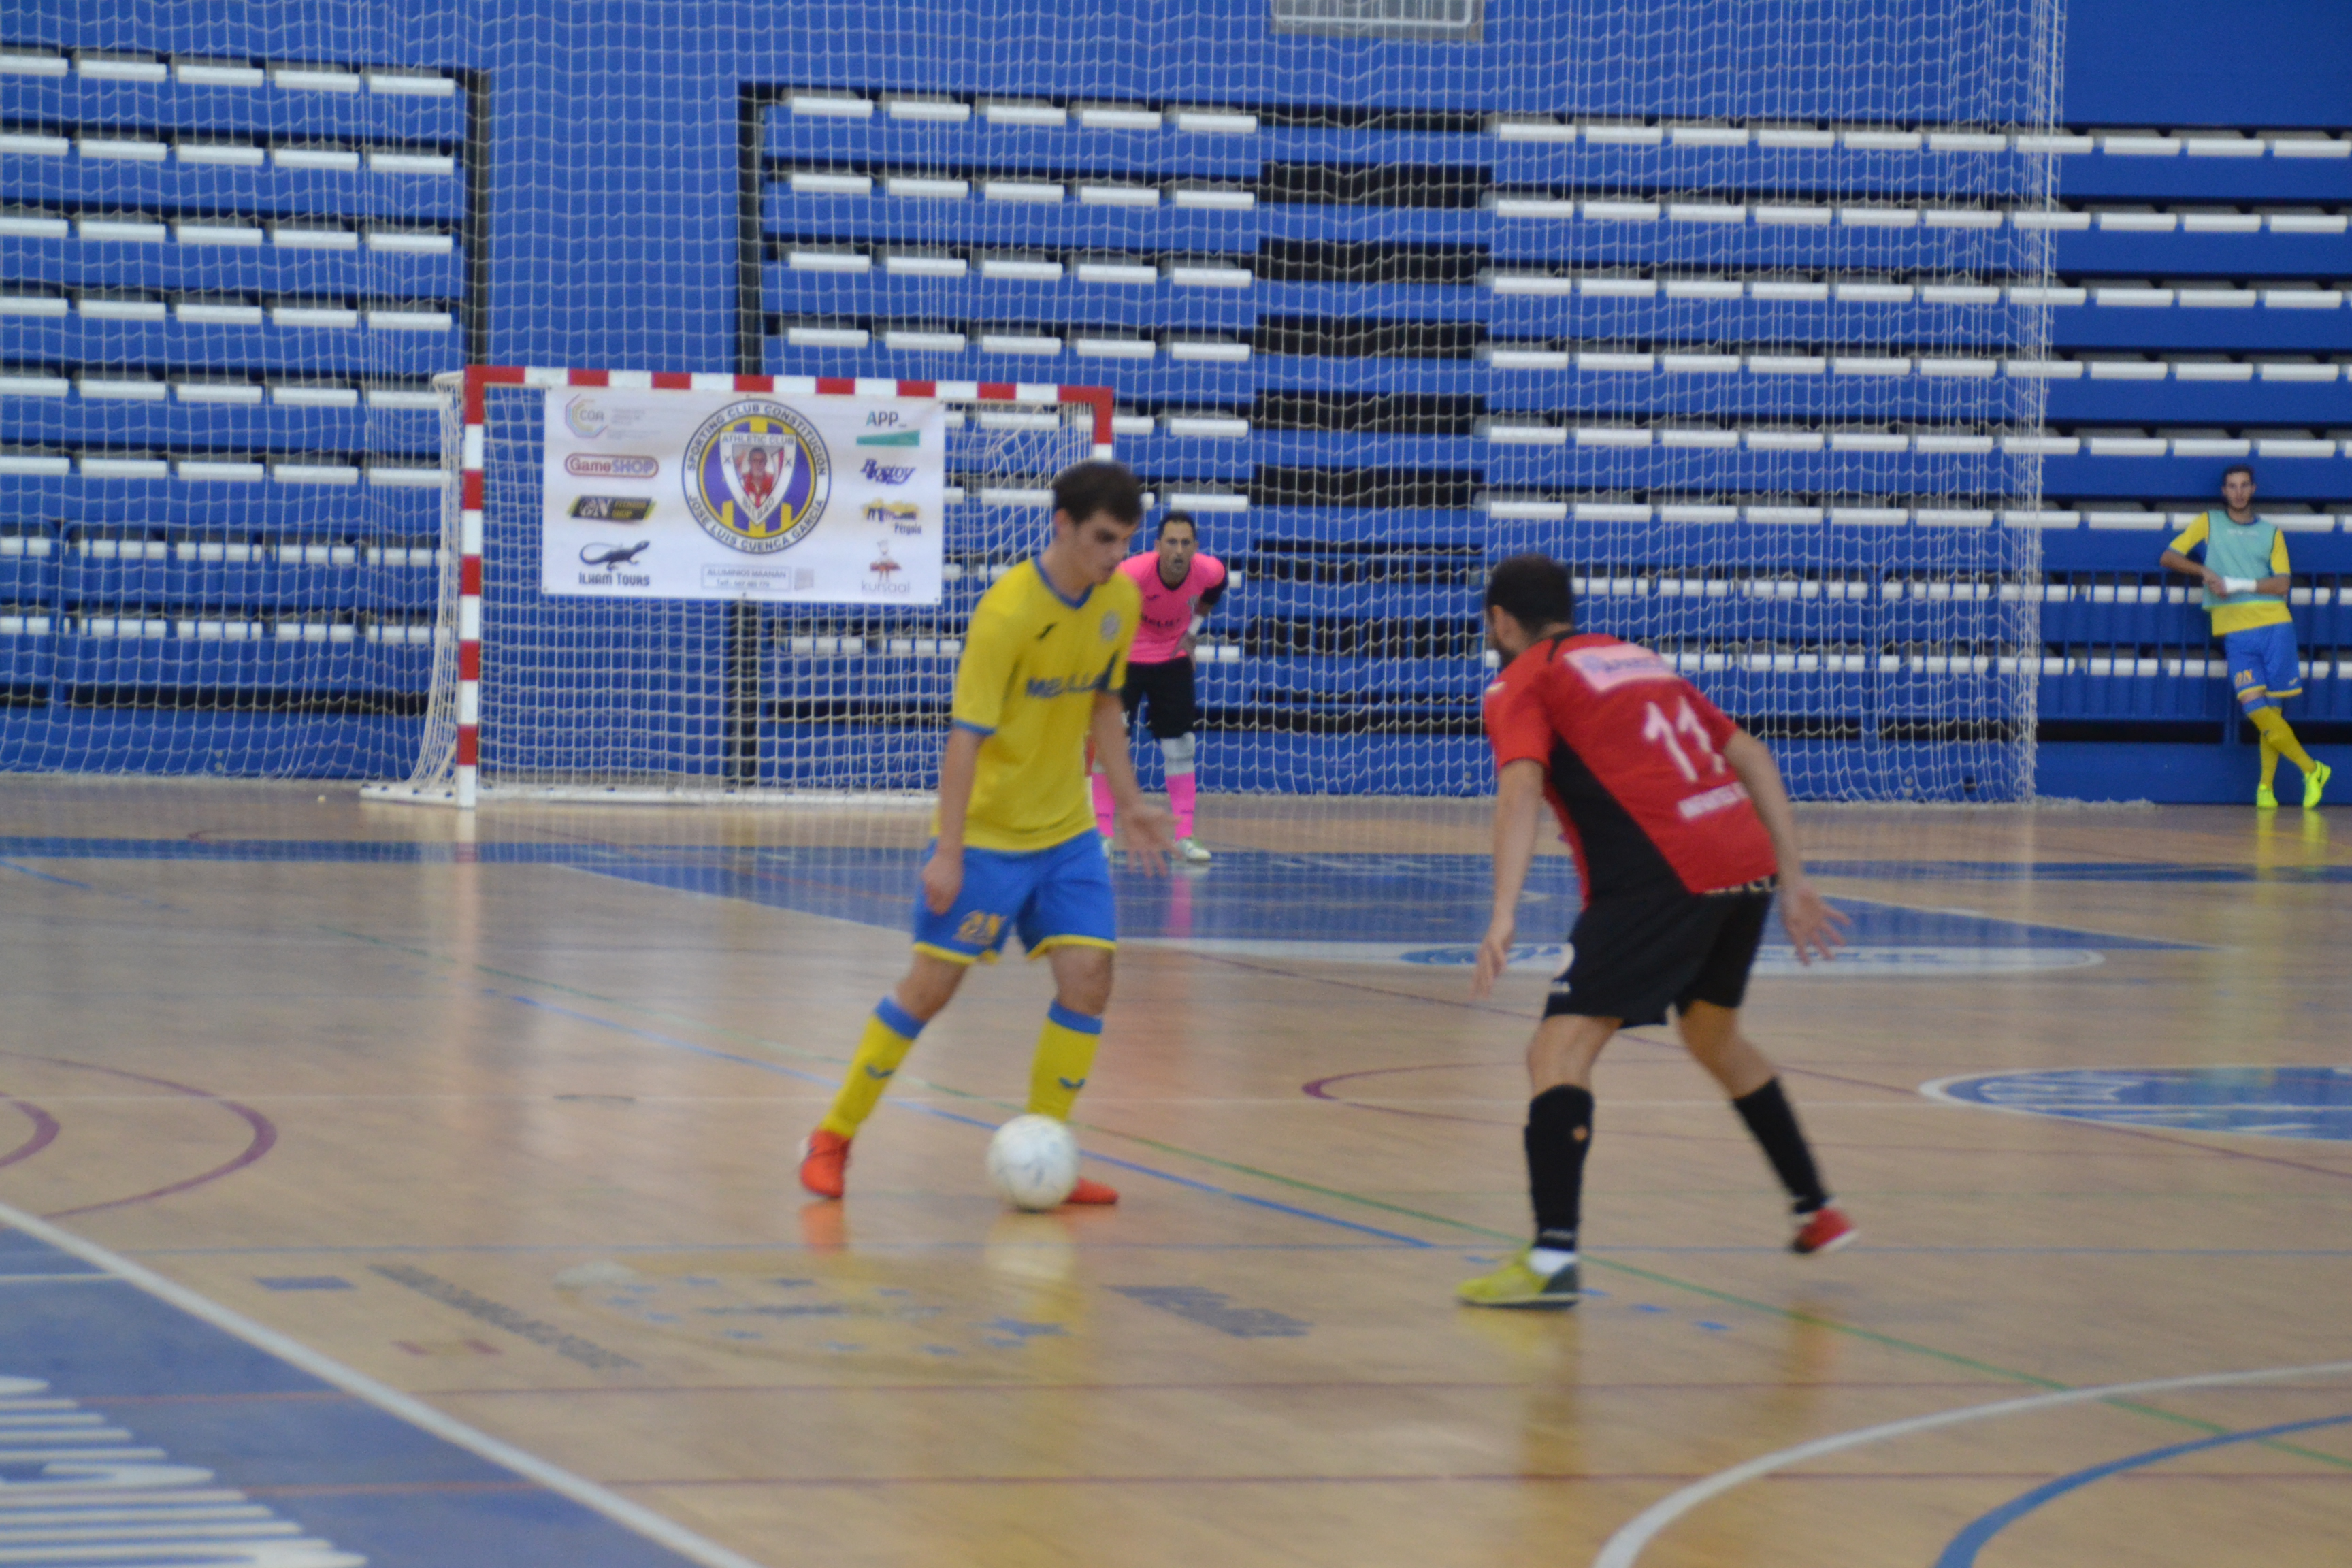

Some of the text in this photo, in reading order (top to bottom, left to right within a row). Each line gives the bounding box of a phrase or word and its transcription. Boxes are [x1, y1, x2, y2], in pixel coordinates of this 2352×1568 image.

[728, 405, 760, 419] CLUB
[769, 436, 794, 445] CLUB
[740, 536, 791, 551] CUENCA
[1643, 694, 1726, 783] 11
